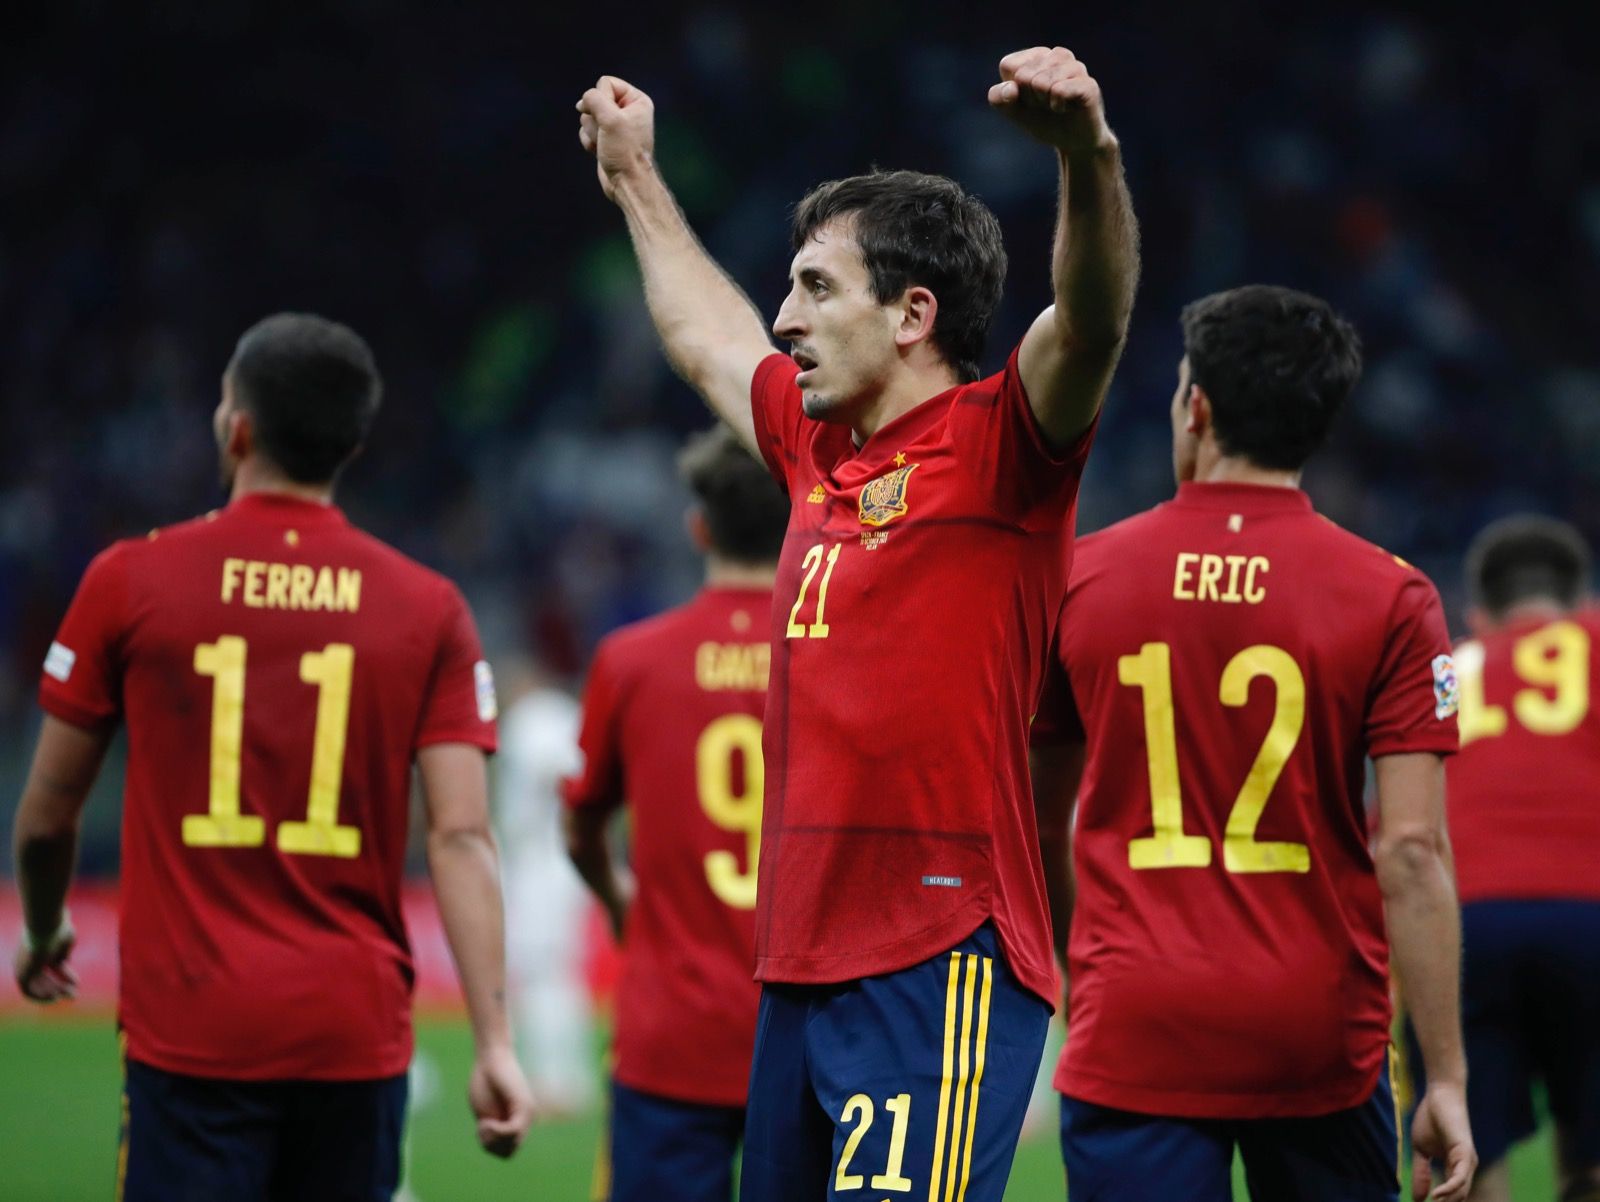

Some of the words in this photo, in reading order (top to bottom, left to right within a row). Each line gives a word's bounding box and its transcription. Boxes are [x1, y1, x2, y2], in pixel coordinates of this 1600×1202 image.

[221, 558, 362, 613] FERRAN
[786, 543, 841, 639] 21
[1172, 552, 1270, 605] ERIC
[181, 635, 362, 858] 11
[1118, 642, 1310, 874] 12
[695, 713, 764, 910] 9
[834, 1094, 912, 1193] 21
